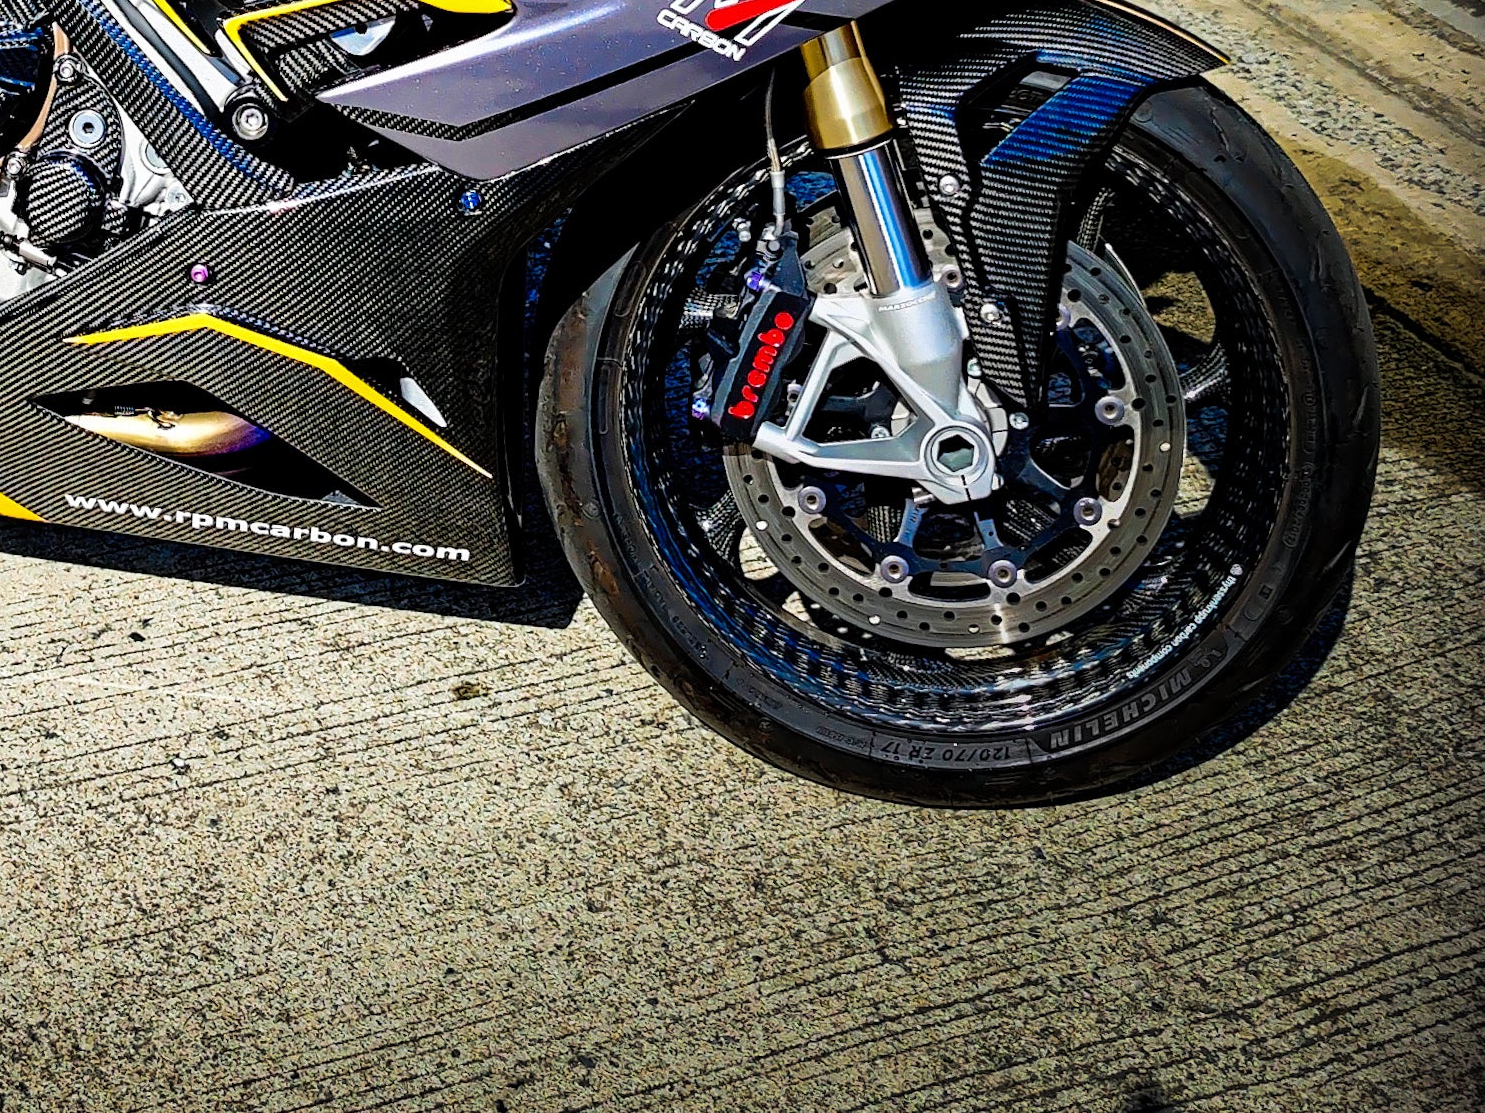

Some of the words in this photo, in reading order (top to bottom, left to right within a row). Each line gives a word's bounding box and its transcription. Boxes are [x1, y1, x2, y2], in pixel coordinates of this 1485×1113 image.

[656, 9, 747, 61] CARBON
[728, 312, 795, 419] brembo
[64, 493, 471, 562] www.rpmcarbon.com
[1050, 669, 1192, 749] MICHELIN
[880, 741, 901, 755] 17
[909, 745, 935, 761] ZR
[942, 746, 1011, 762] 120/70
